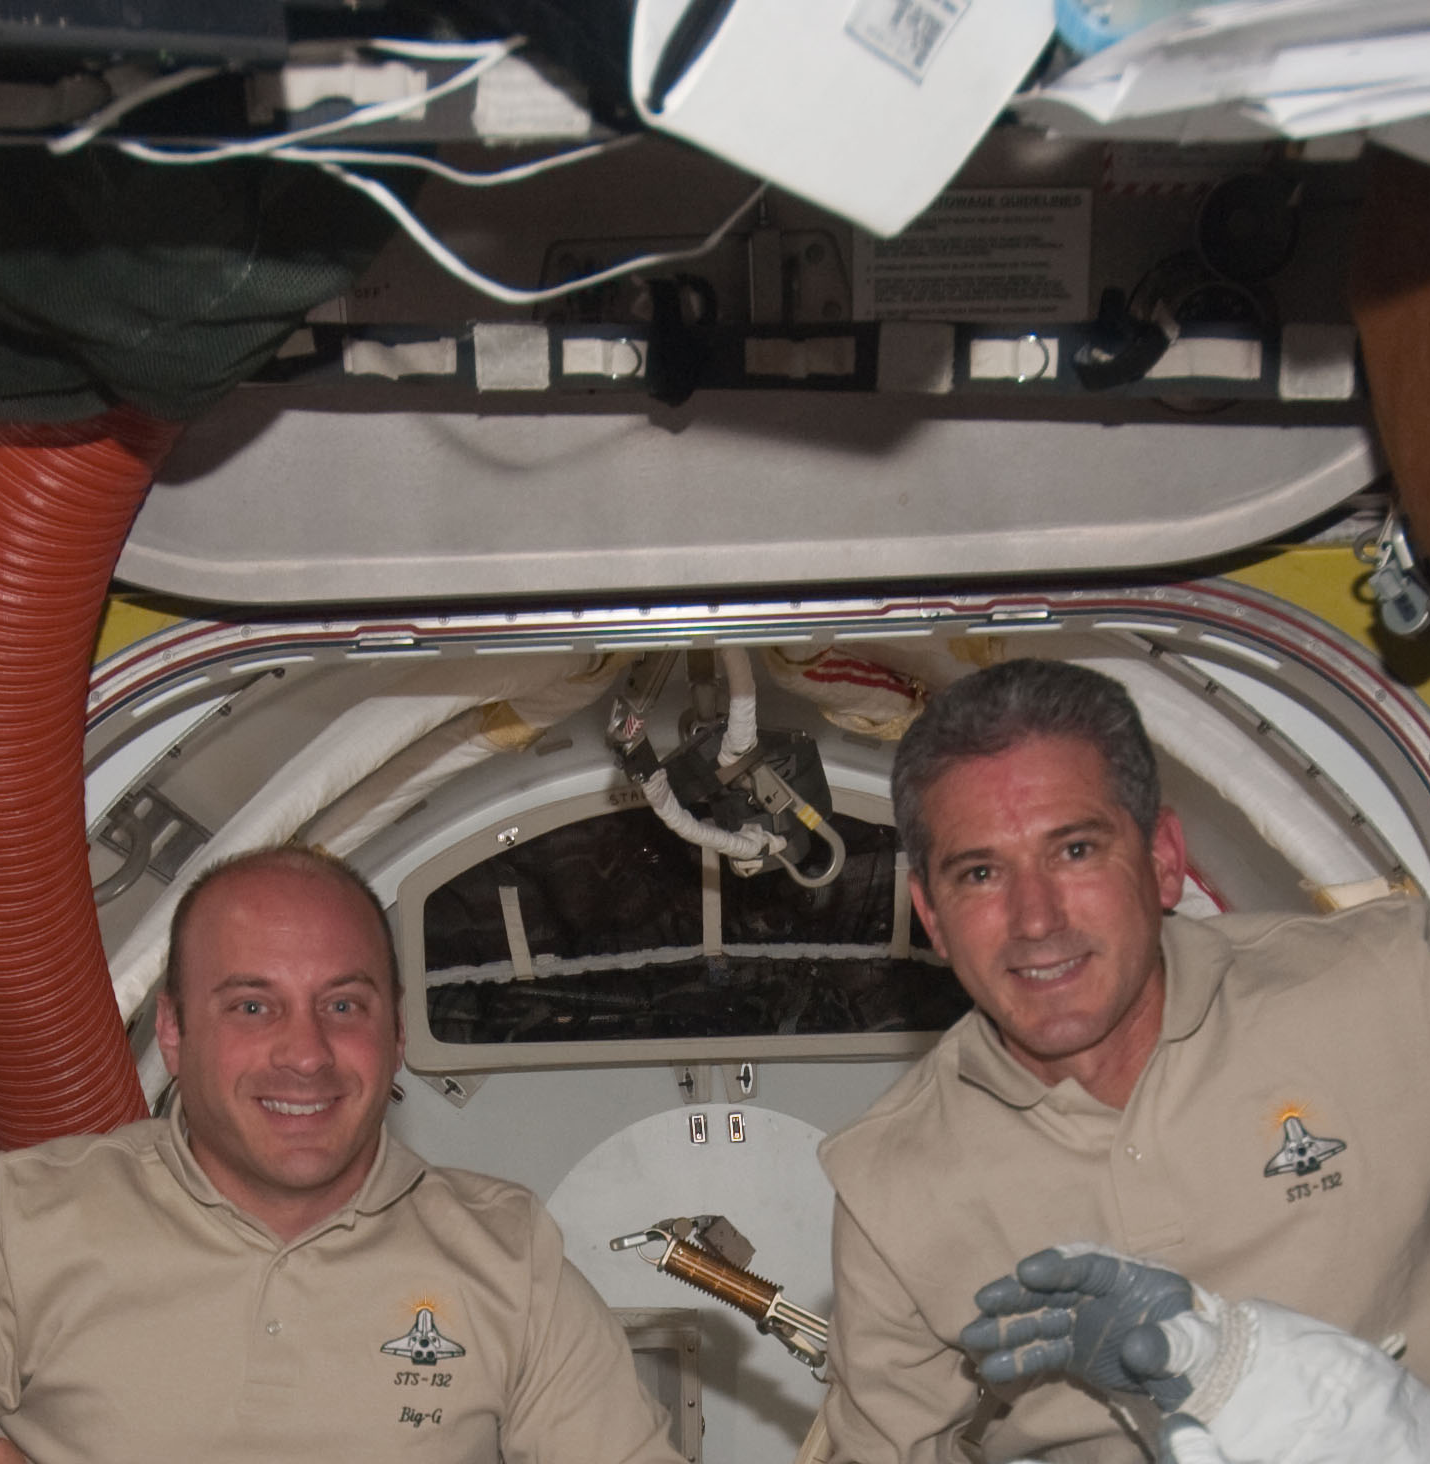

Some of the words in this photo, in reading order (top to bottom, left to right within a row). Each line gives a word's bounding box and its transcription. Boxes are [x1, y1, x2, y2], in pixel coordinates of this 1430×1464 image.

[932, 194, 995, 209] TOWAGE
[1001, 194, 1083, 208] GUIDELINES
[1285, 1171, 1344, 1203] STS-132
[393, 1371, 453, 1388] STS-132
[398, 1405, 443, 1428] Big-G
